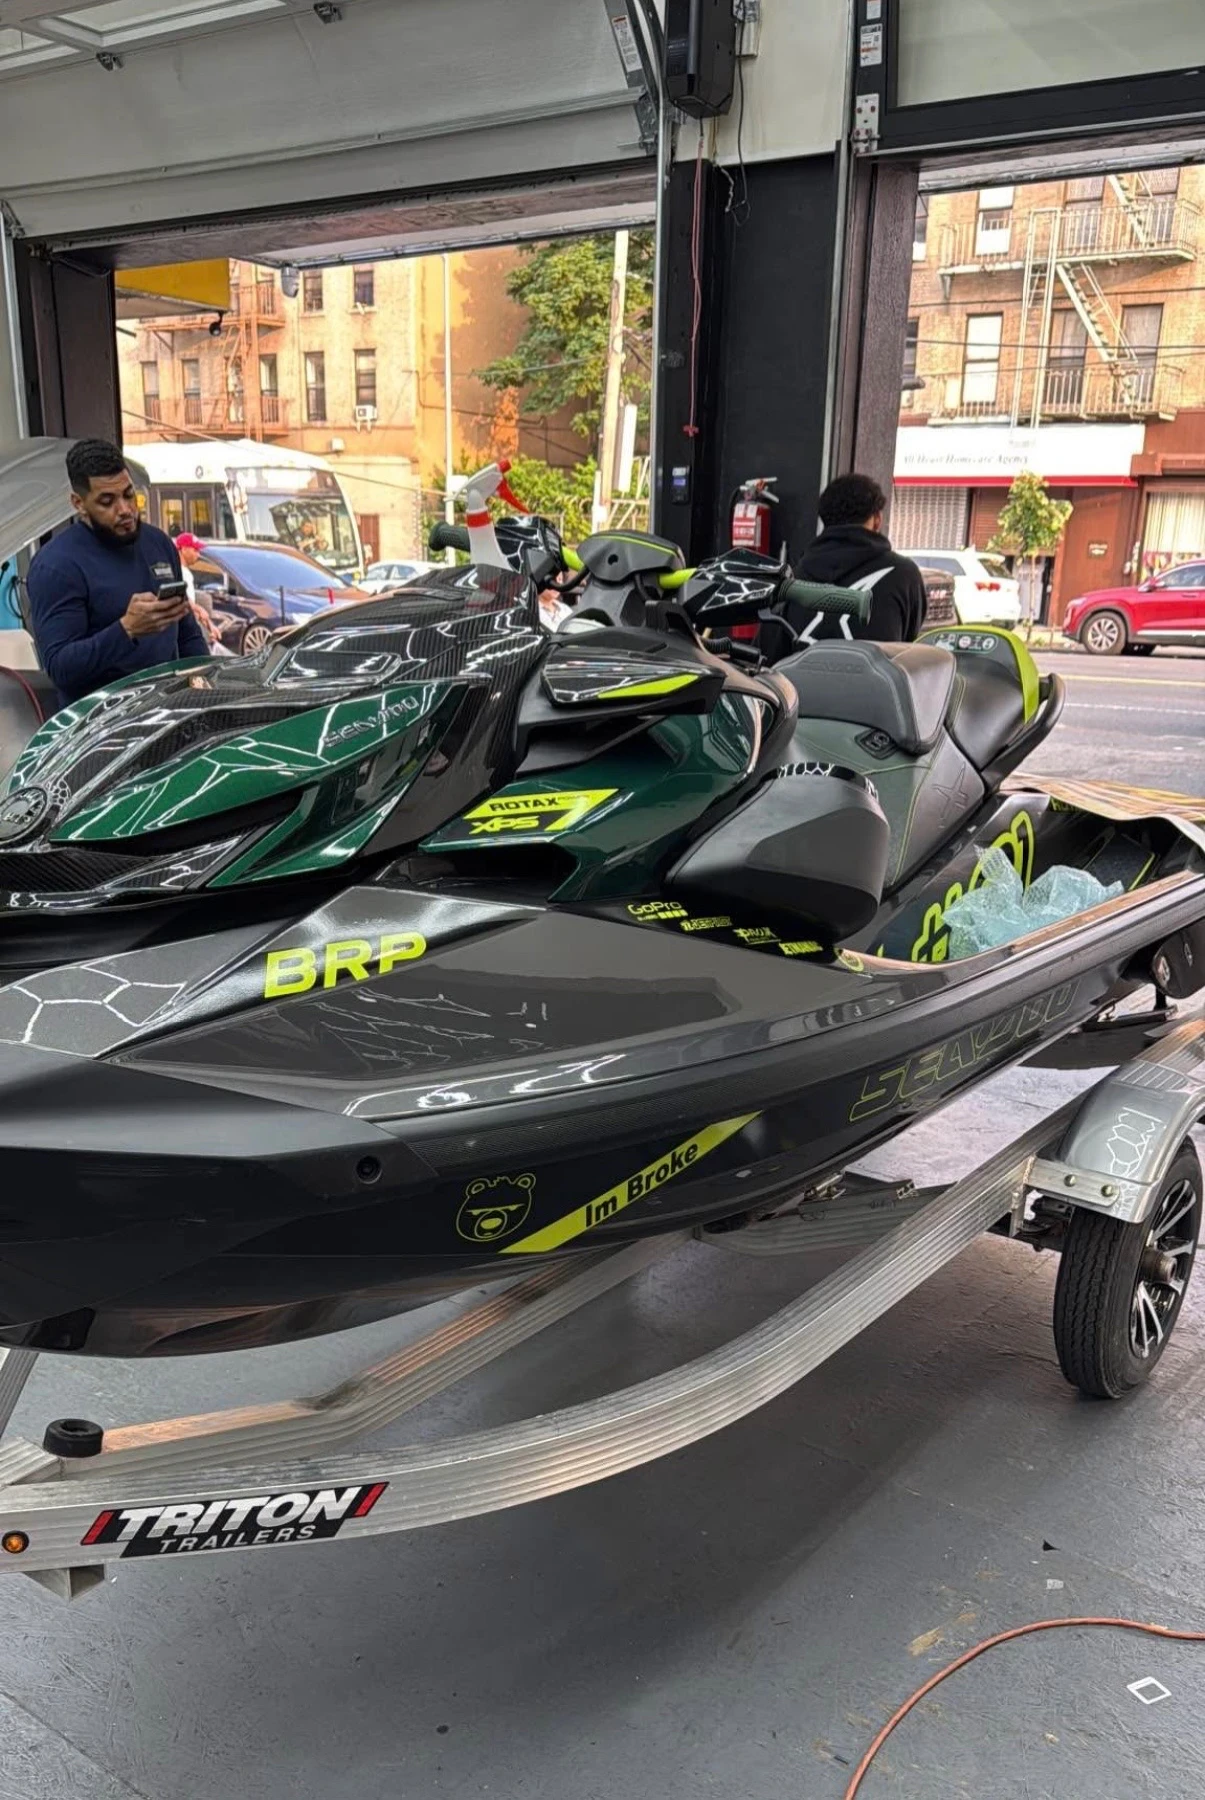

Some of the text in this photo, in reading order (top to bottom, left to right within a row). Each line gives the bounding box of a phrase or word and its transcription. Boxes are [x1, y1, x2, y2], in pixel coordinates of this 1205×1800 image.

[488, 797, 560, 812] ROTAX
[468, 815, 540, 835] XPS
[627, 901, 683, 916] GoPro
[264, 931, 427, 999] BRP
[585, 1143, 699, 1228] Im Broke
[116, 1486, 363, 1542] TRITON
[159, 1524, 317, 1554] TRAILERS
